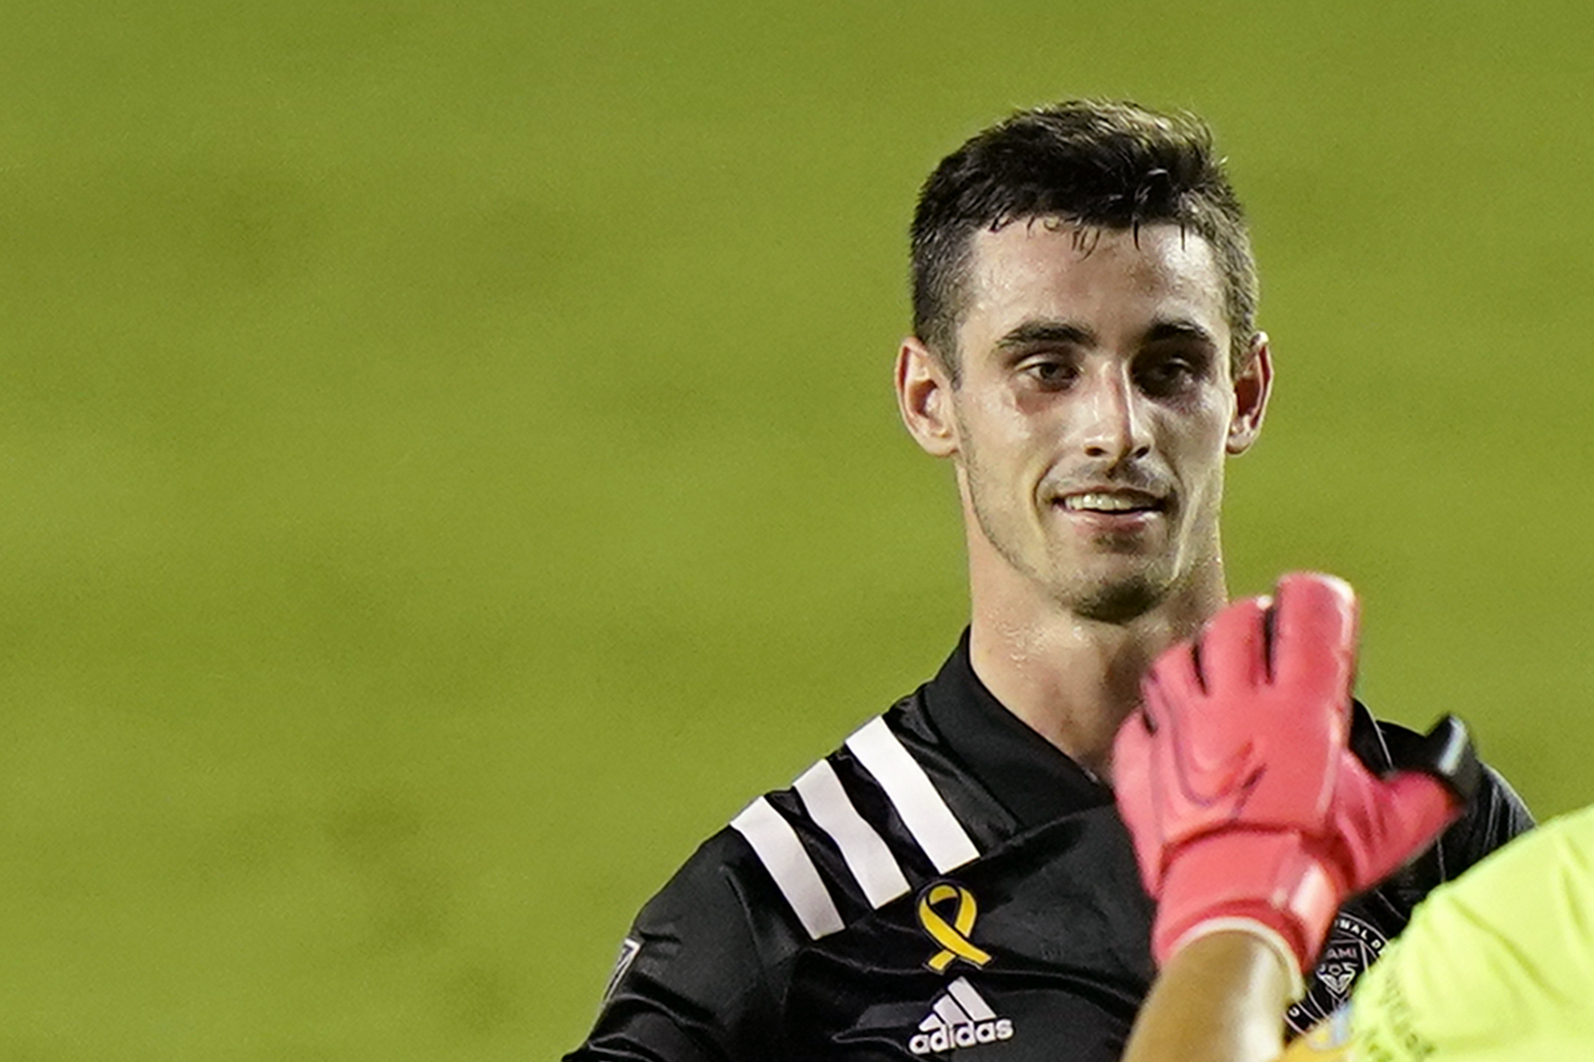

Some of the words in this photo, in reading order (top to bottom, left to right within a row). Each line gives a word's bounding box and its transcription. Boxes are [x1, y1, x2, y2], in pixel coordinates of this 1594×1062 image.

[1334, 918, 1369, 940] NAL
[1326, 946, 1358, 959] AMI
[908, 1018, 1014, 1055] adidas
